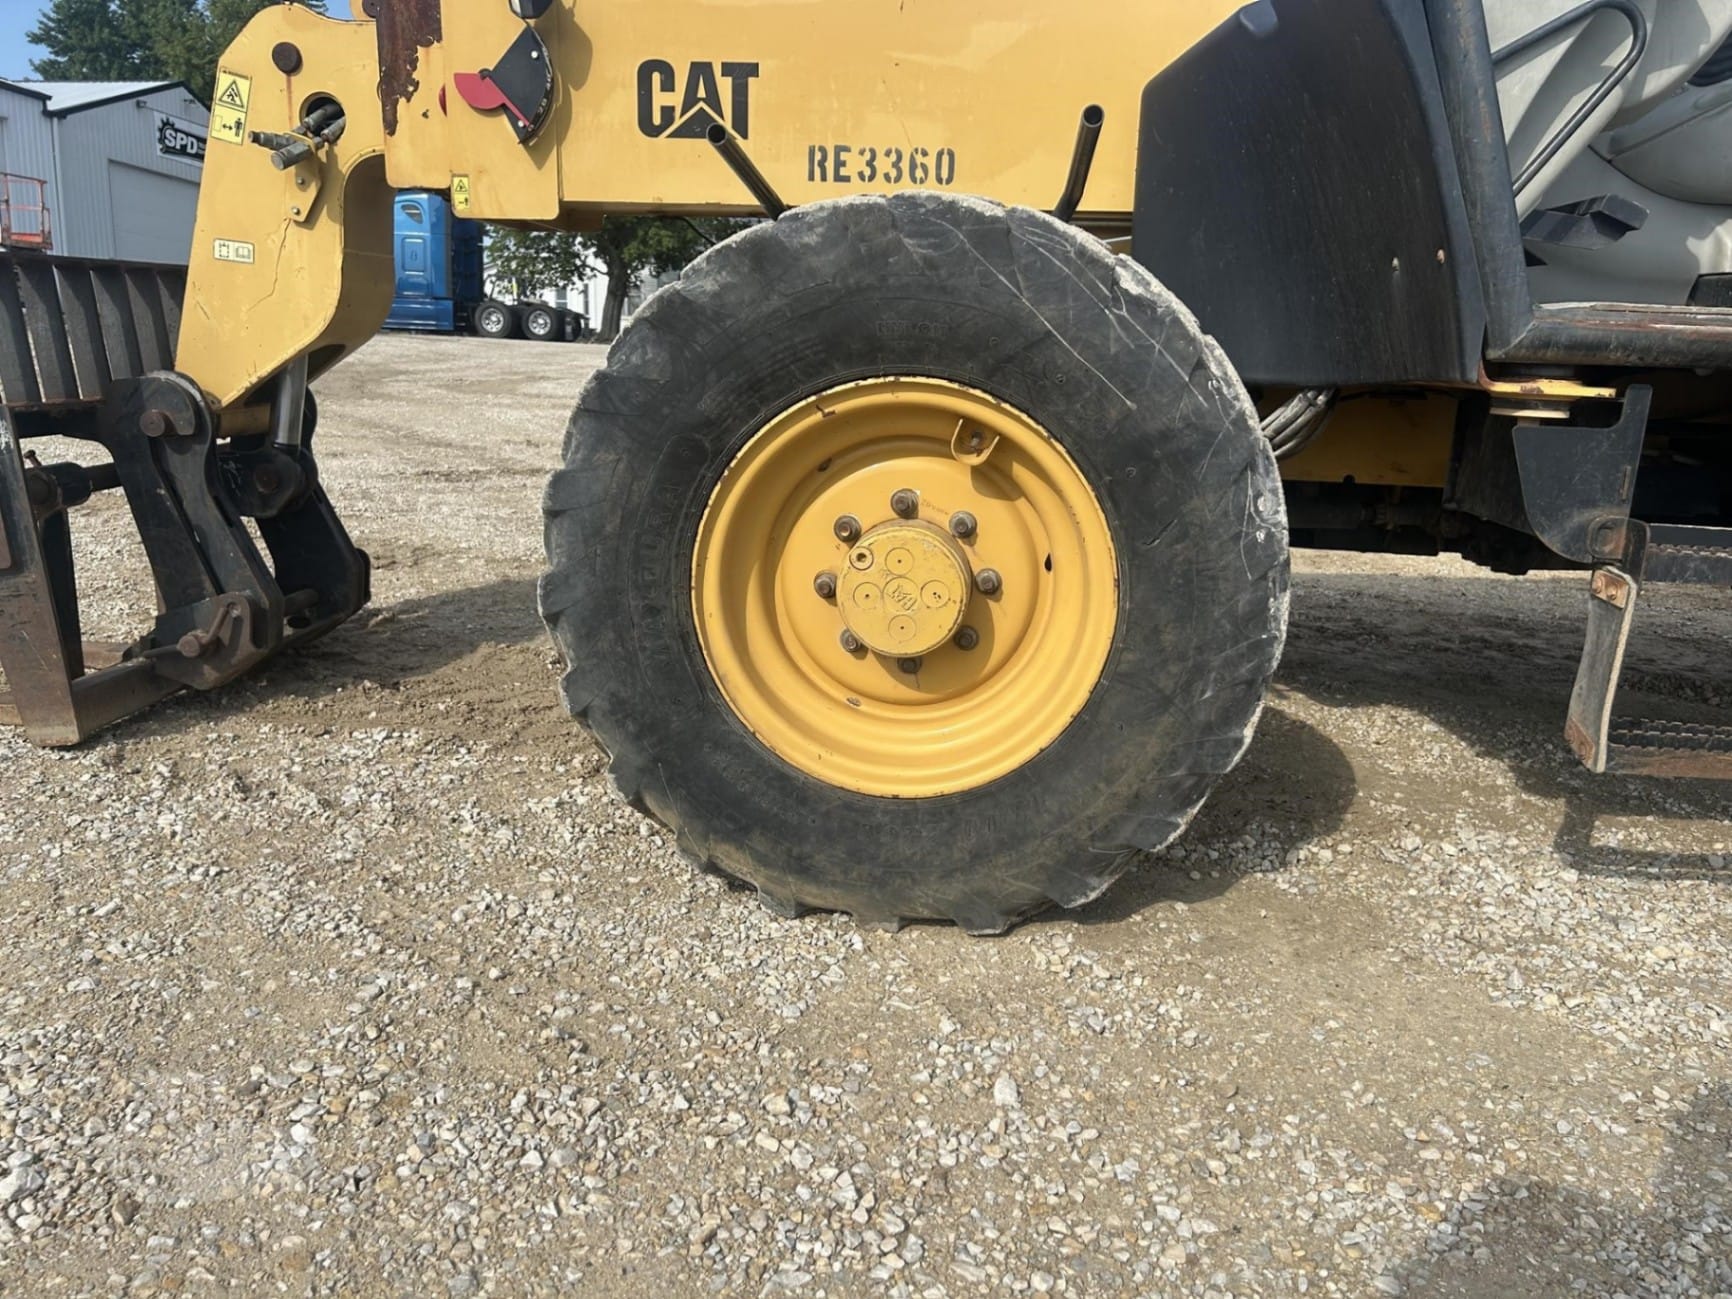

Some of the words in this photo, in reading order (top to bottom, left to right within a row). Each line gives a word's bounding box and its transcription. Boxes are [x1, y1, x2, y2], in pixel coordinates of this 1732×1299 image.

[637, 59, 759, 140] CAT
[164, 129, 198, 154] SPD
[807, 144, 956, 186] RE3360
